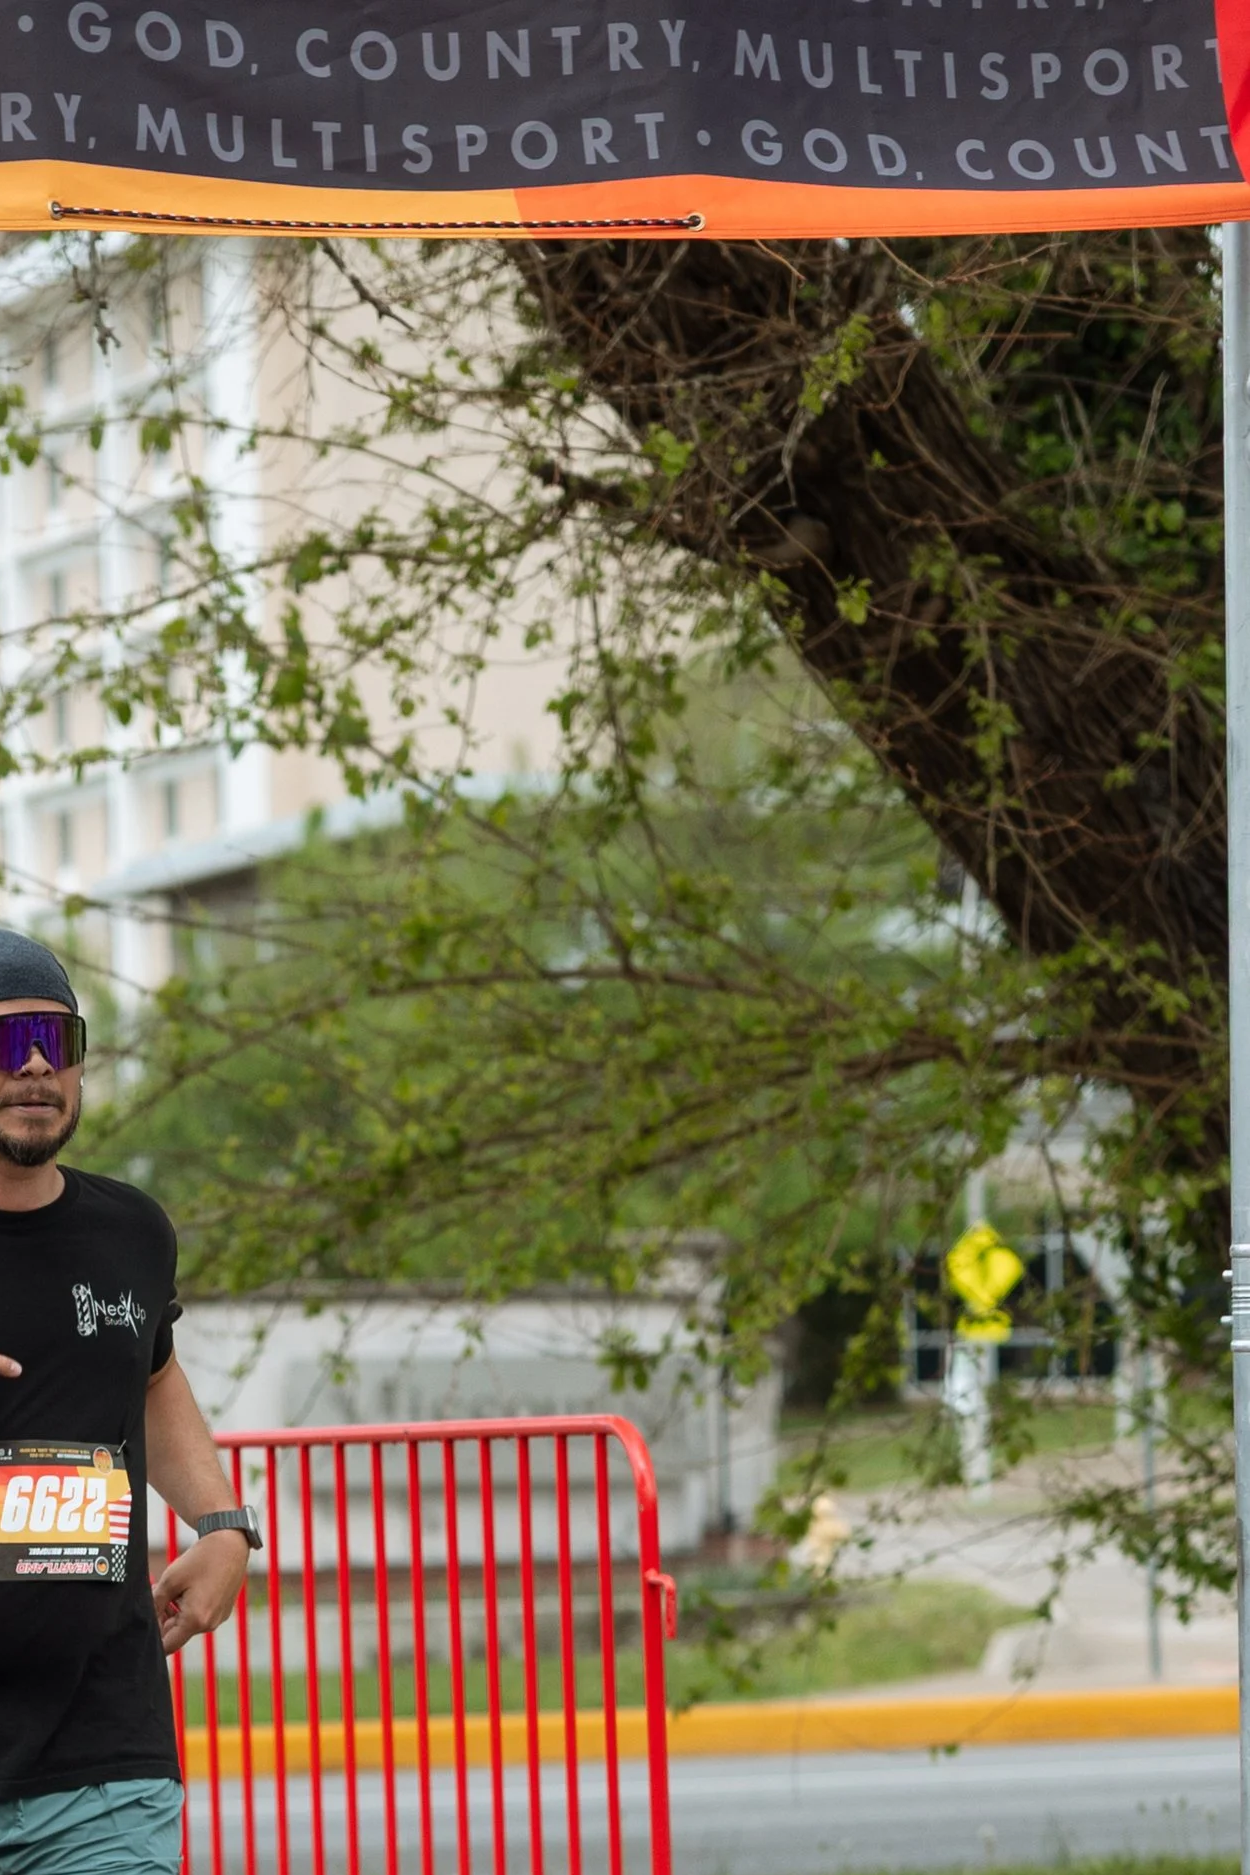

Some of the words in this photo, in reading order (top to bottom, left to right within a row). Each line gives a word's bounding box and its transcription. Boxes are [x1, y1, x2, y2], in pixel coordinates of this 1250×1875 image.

[68, 2, 258, 76] GOD,
[295, 19, 699, 81] COUNTRY,
[136, 103, 665, 174] MULTISPORT
[740, 119, 924, 182] GOD,
[132, 1302, 147, 1325] Up
